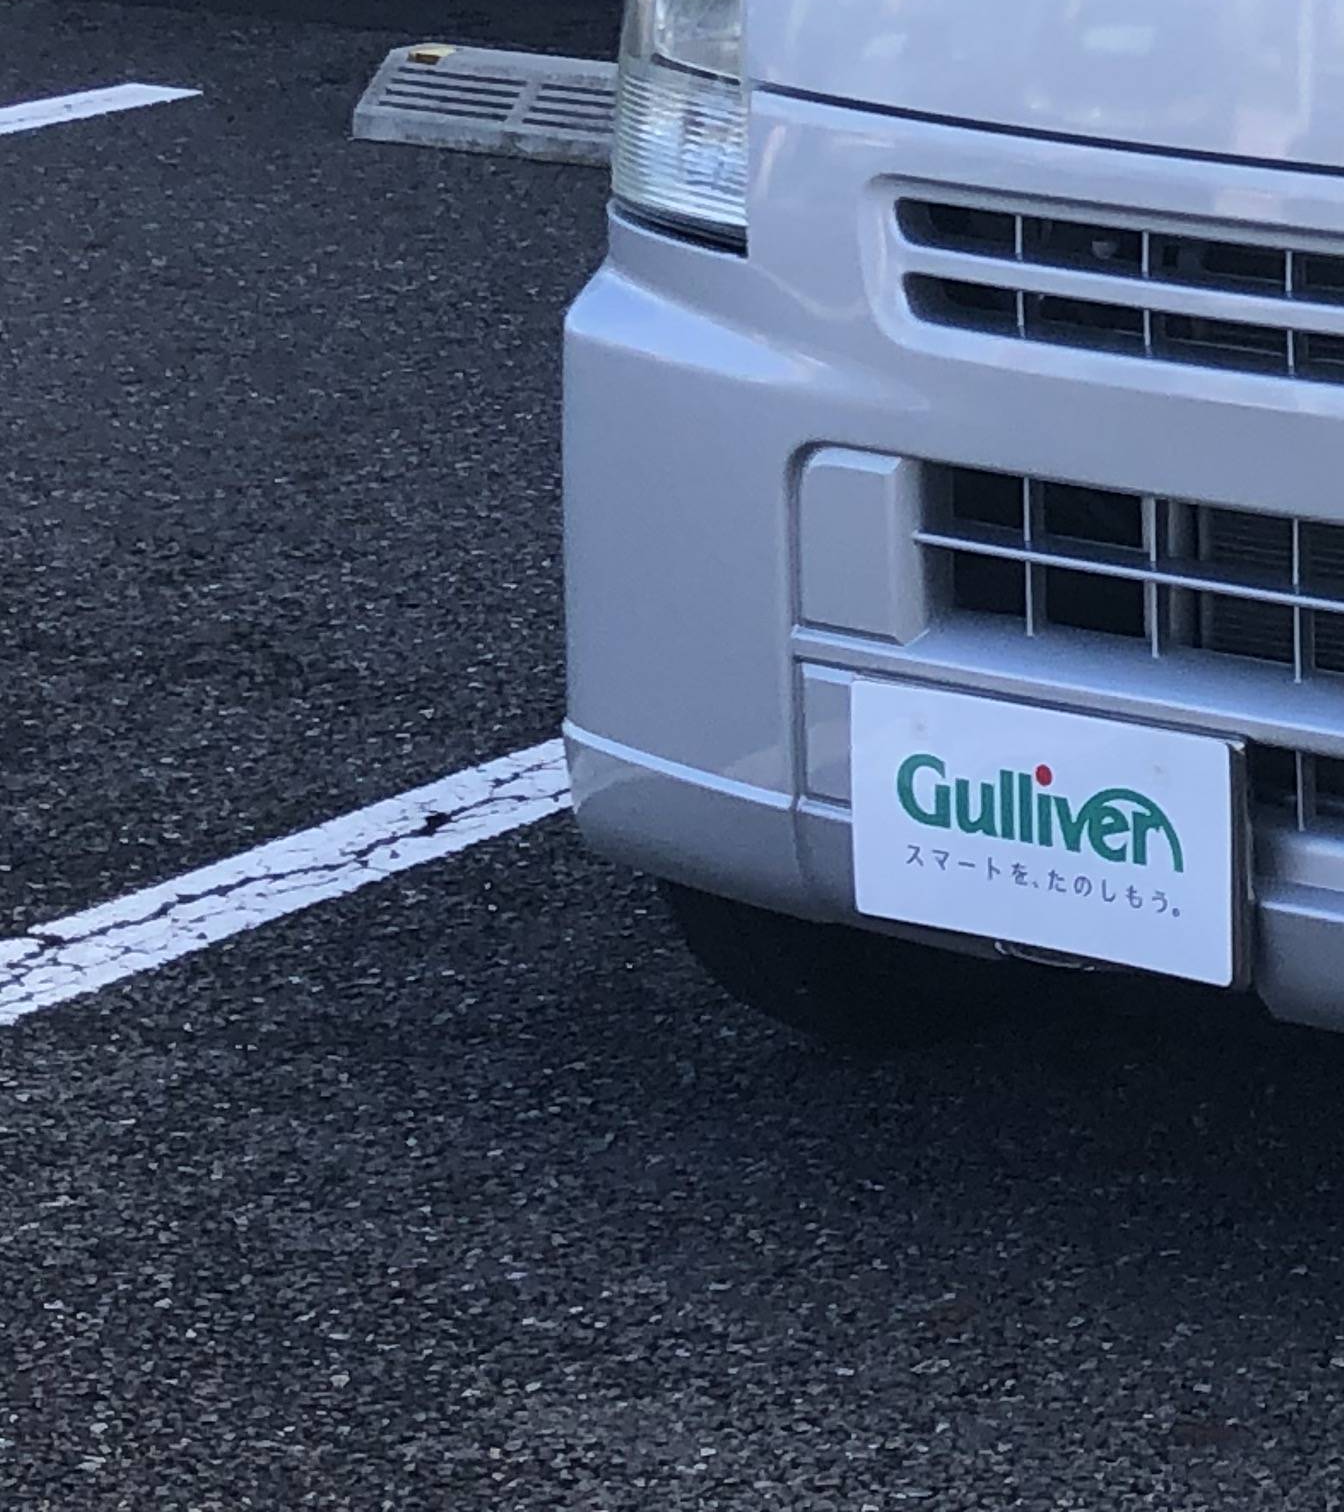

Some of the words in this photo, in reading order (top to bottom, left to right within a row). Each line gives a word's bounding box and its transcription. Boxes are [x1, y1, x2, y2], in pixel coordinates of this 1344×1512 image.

[896, 753, 1184, 873] Gulliver
[905, 844, 1182, 919] スマートを、たのしもう。
